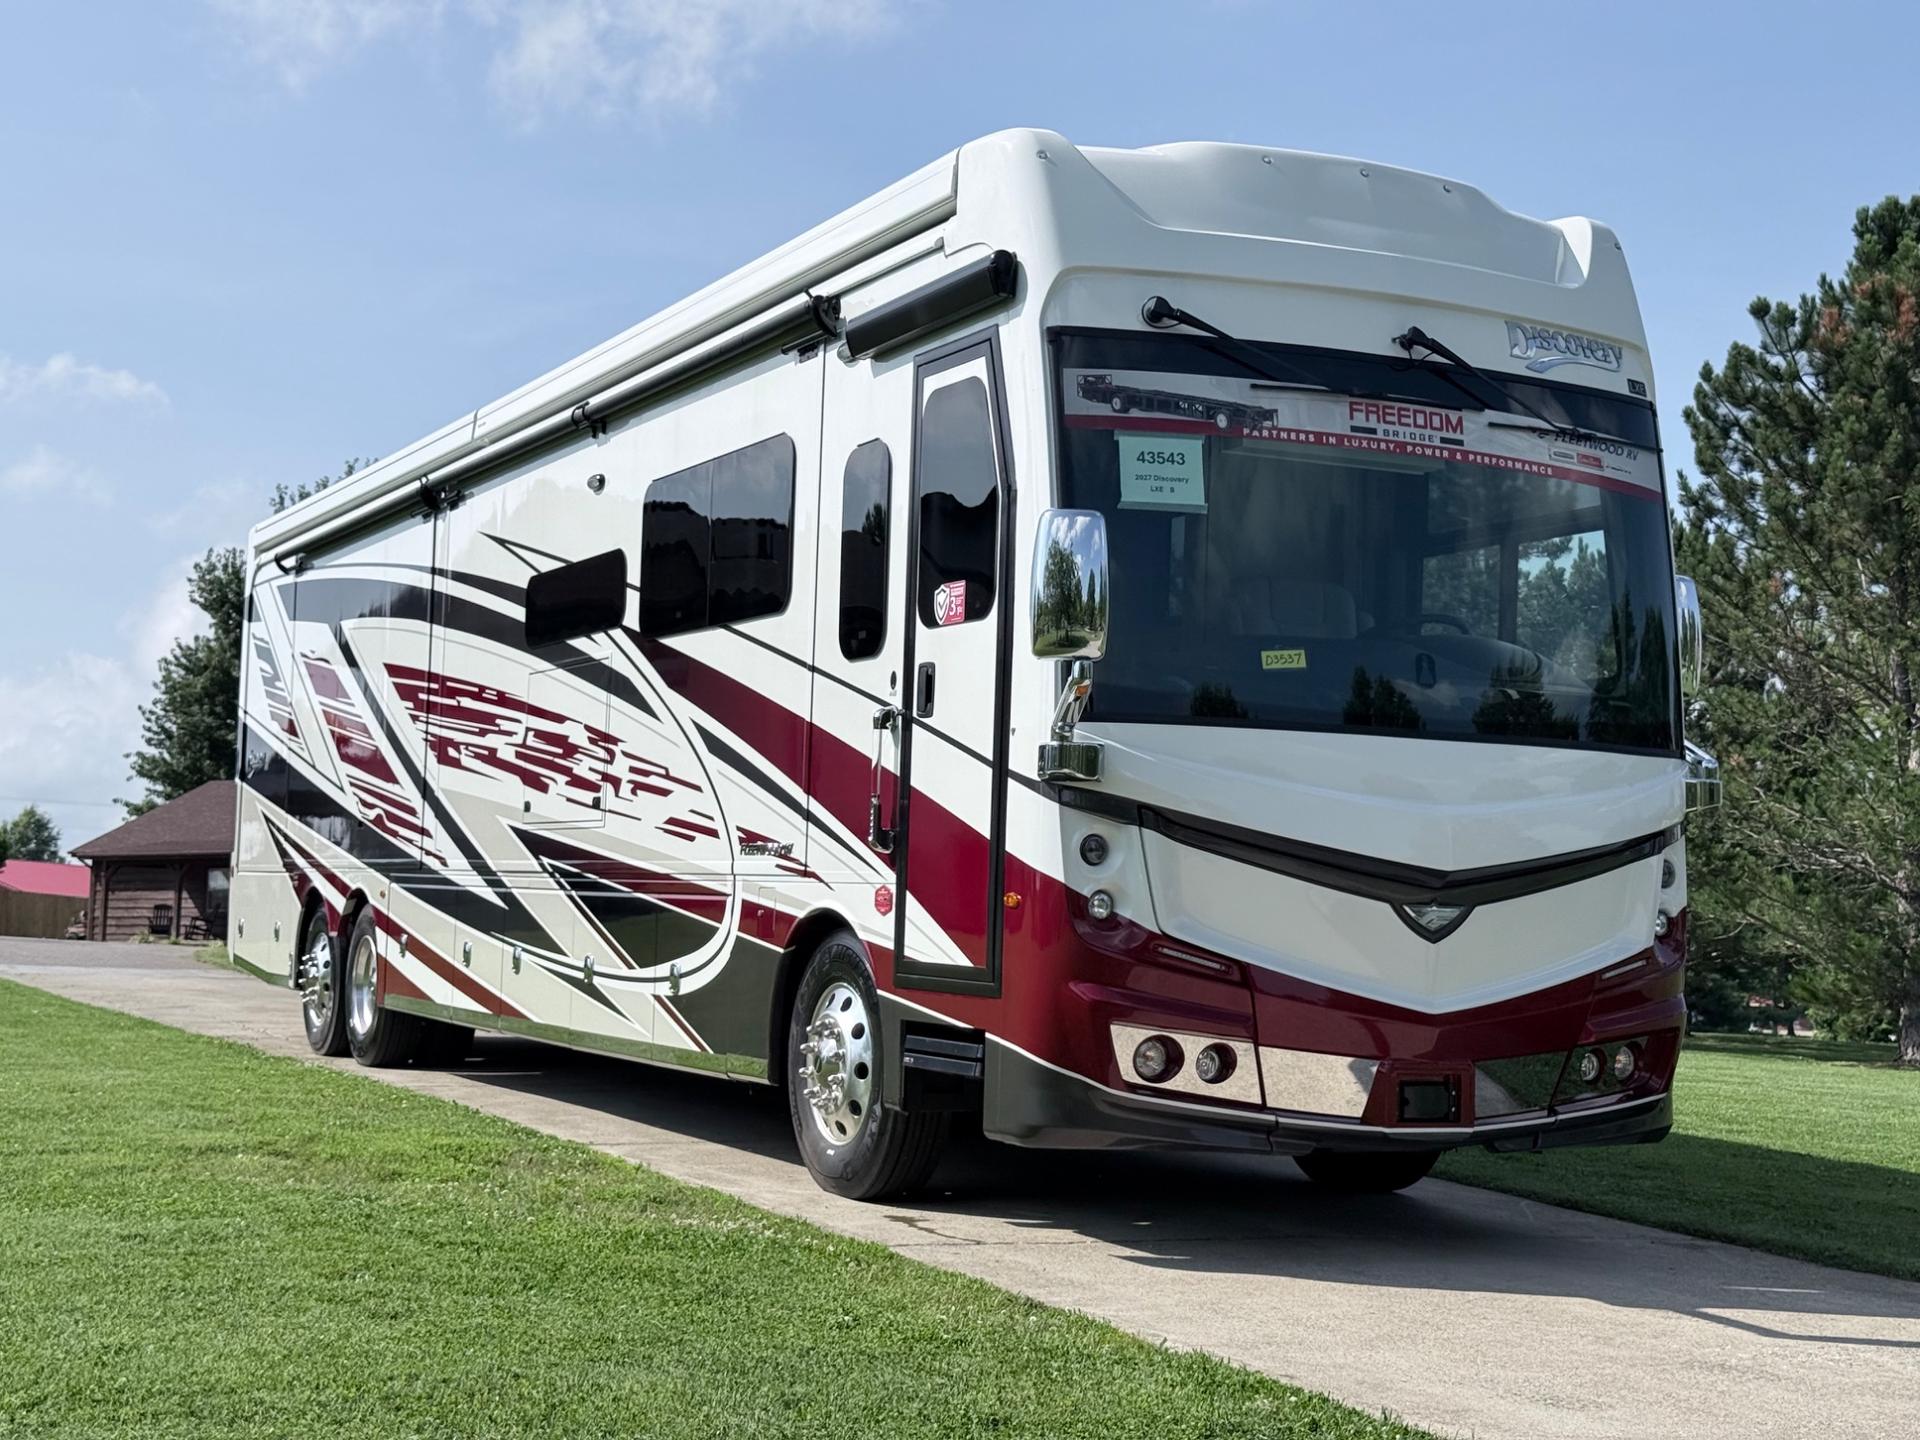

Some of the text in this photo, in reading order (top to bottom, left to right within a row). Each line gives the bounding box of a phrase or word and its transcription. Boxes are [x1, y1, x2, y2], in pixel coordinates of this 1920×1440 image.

[1628, 381, 1646, 395] LXE
[1348, 401, 1464, 435] FREEDOM
[1243, 427, 1315, 442] PARTNERS
[1323, 435, 1336, 445] IN
[1344, 438, 1400, 452] LUXURY,
[1406, 445, 1449, 458] POWER
[1455, 452, 1462, 460] &
[1469, 454, 1553, 475] PERFORMANCE
[1626, 449, 1639, 461] RV
[1136, 450, 1186, 466] 43543
[1153, 475, 1190, 484] Discovery
[1150, 485, 1164, 493] LXE
[1265, 653, 1302, 666] D3537
